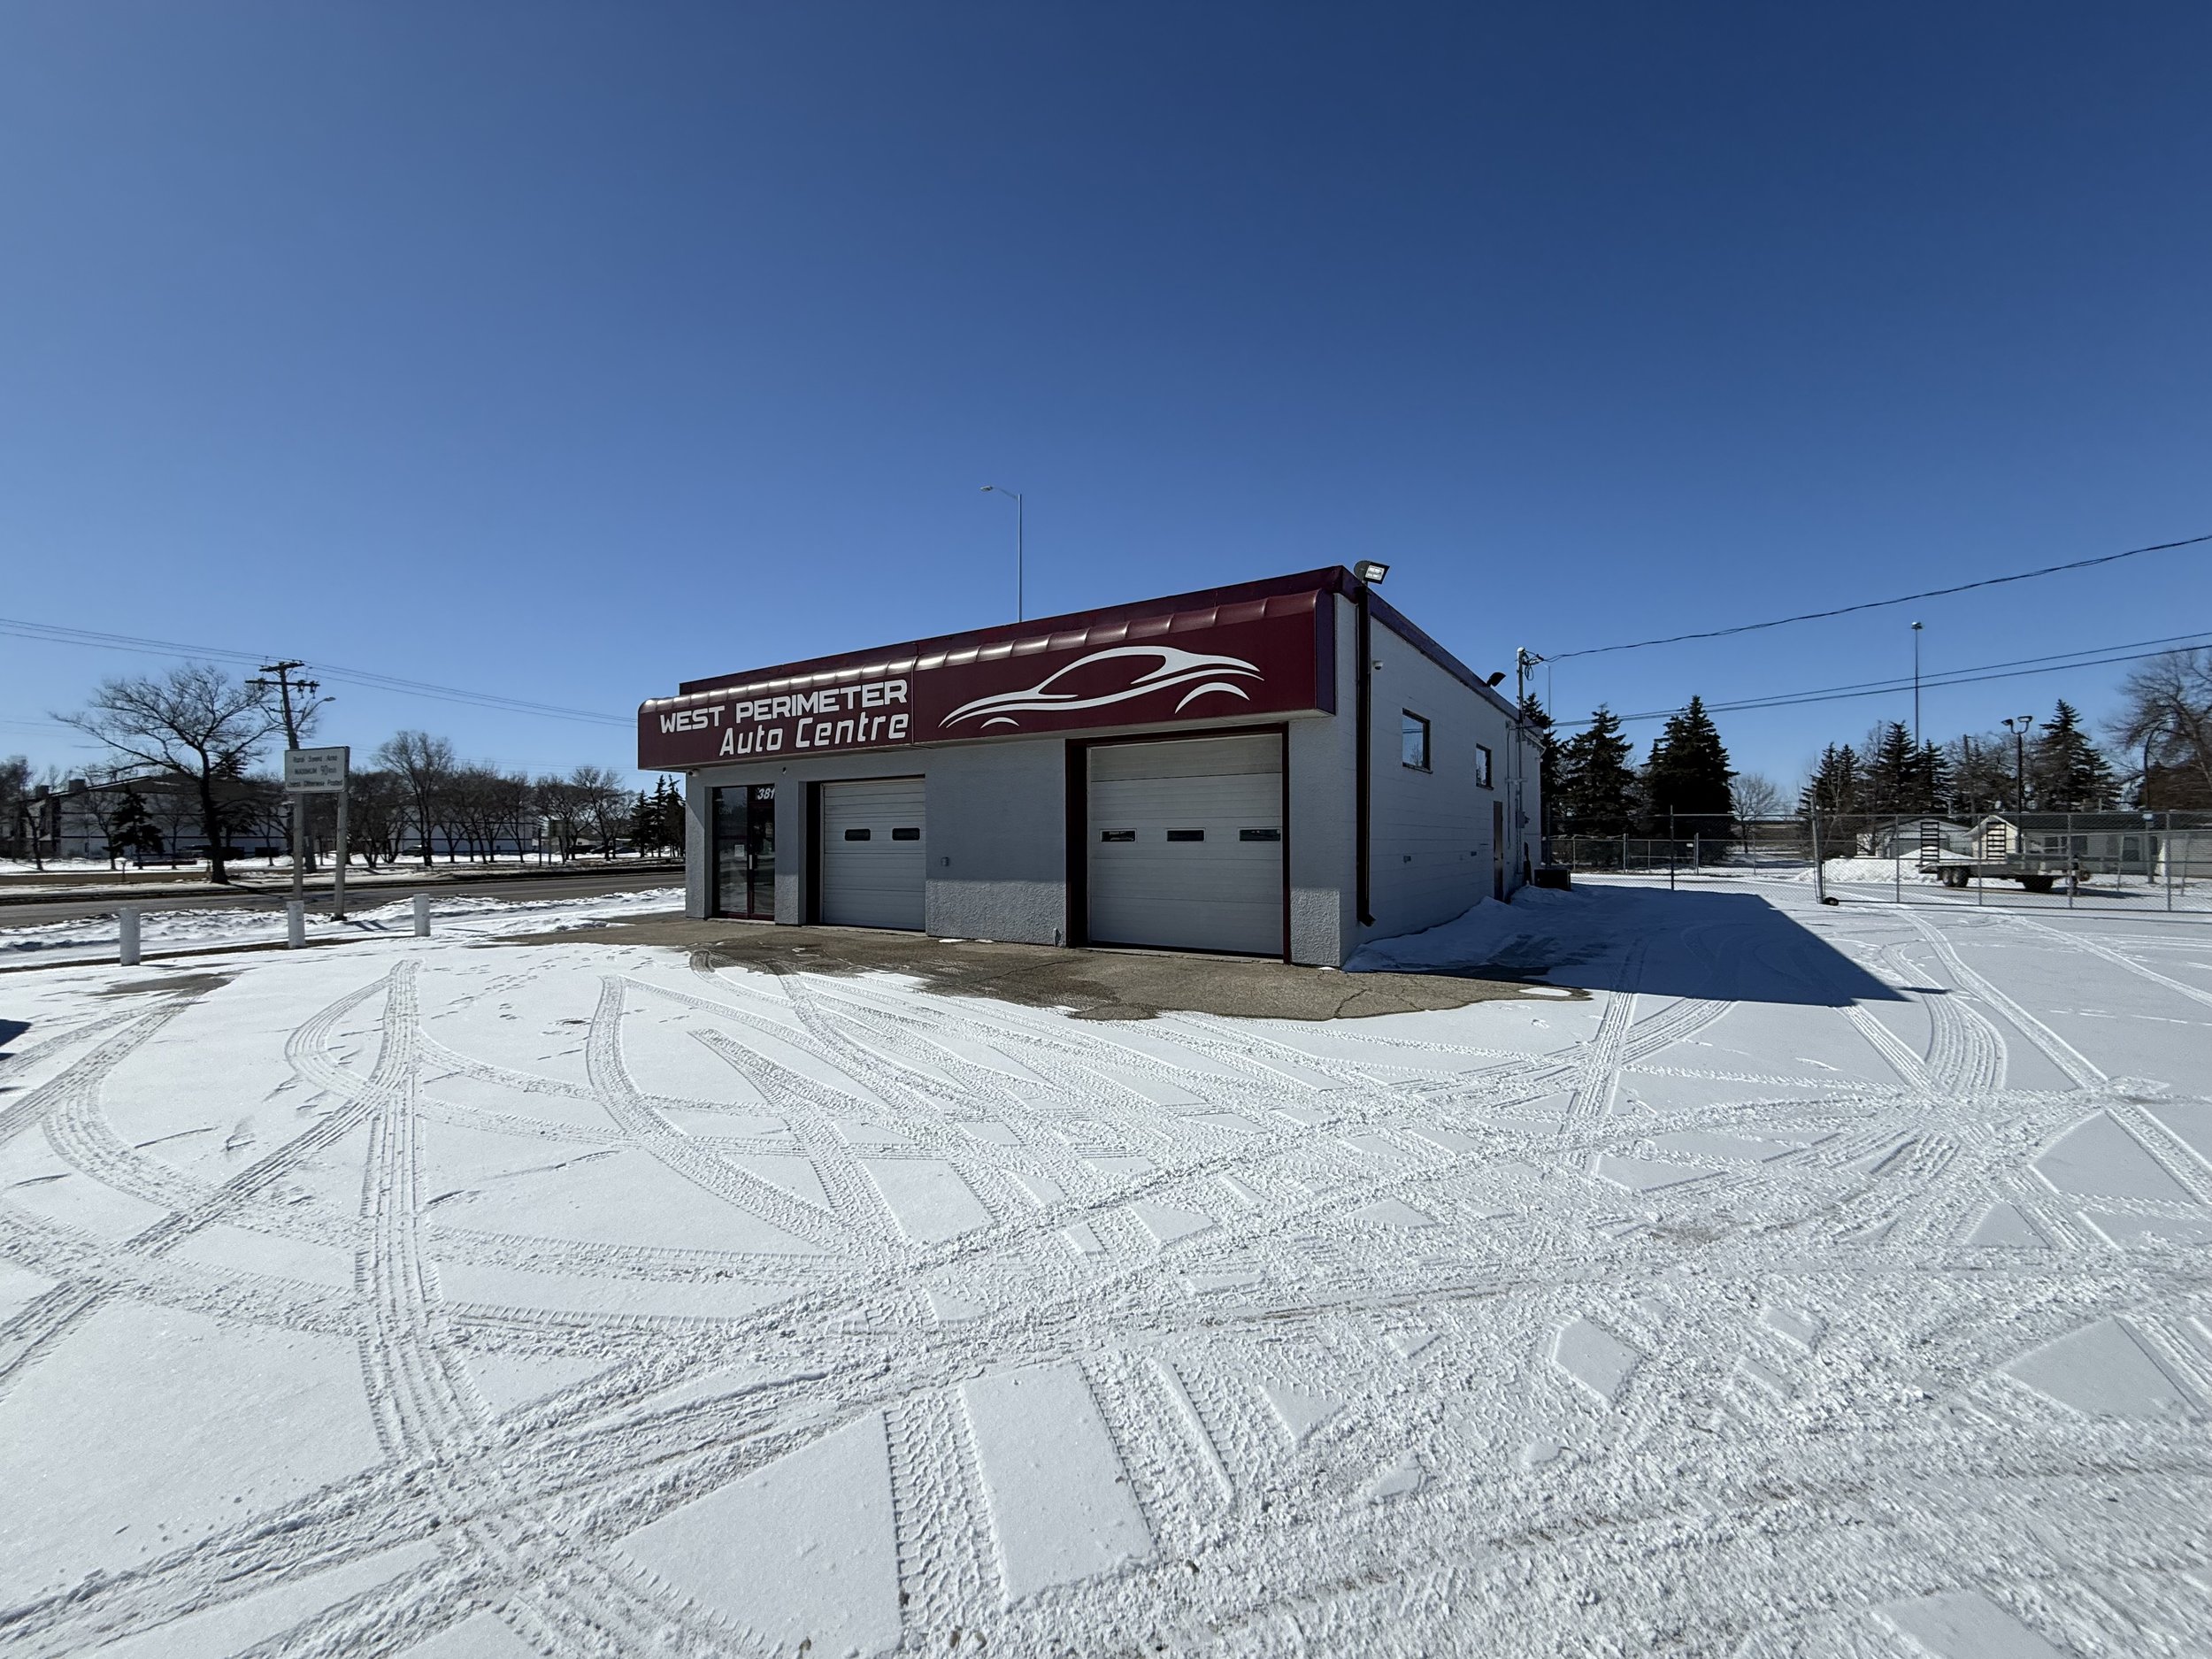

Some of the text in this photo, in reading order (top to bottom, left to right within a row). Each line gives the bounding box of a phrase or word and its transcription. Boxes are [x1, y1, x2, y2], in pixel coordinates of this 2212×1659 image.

[659, 680, 908, 733] WEST PERIMETER
[718, 711, 910, 757] Auto Centre
